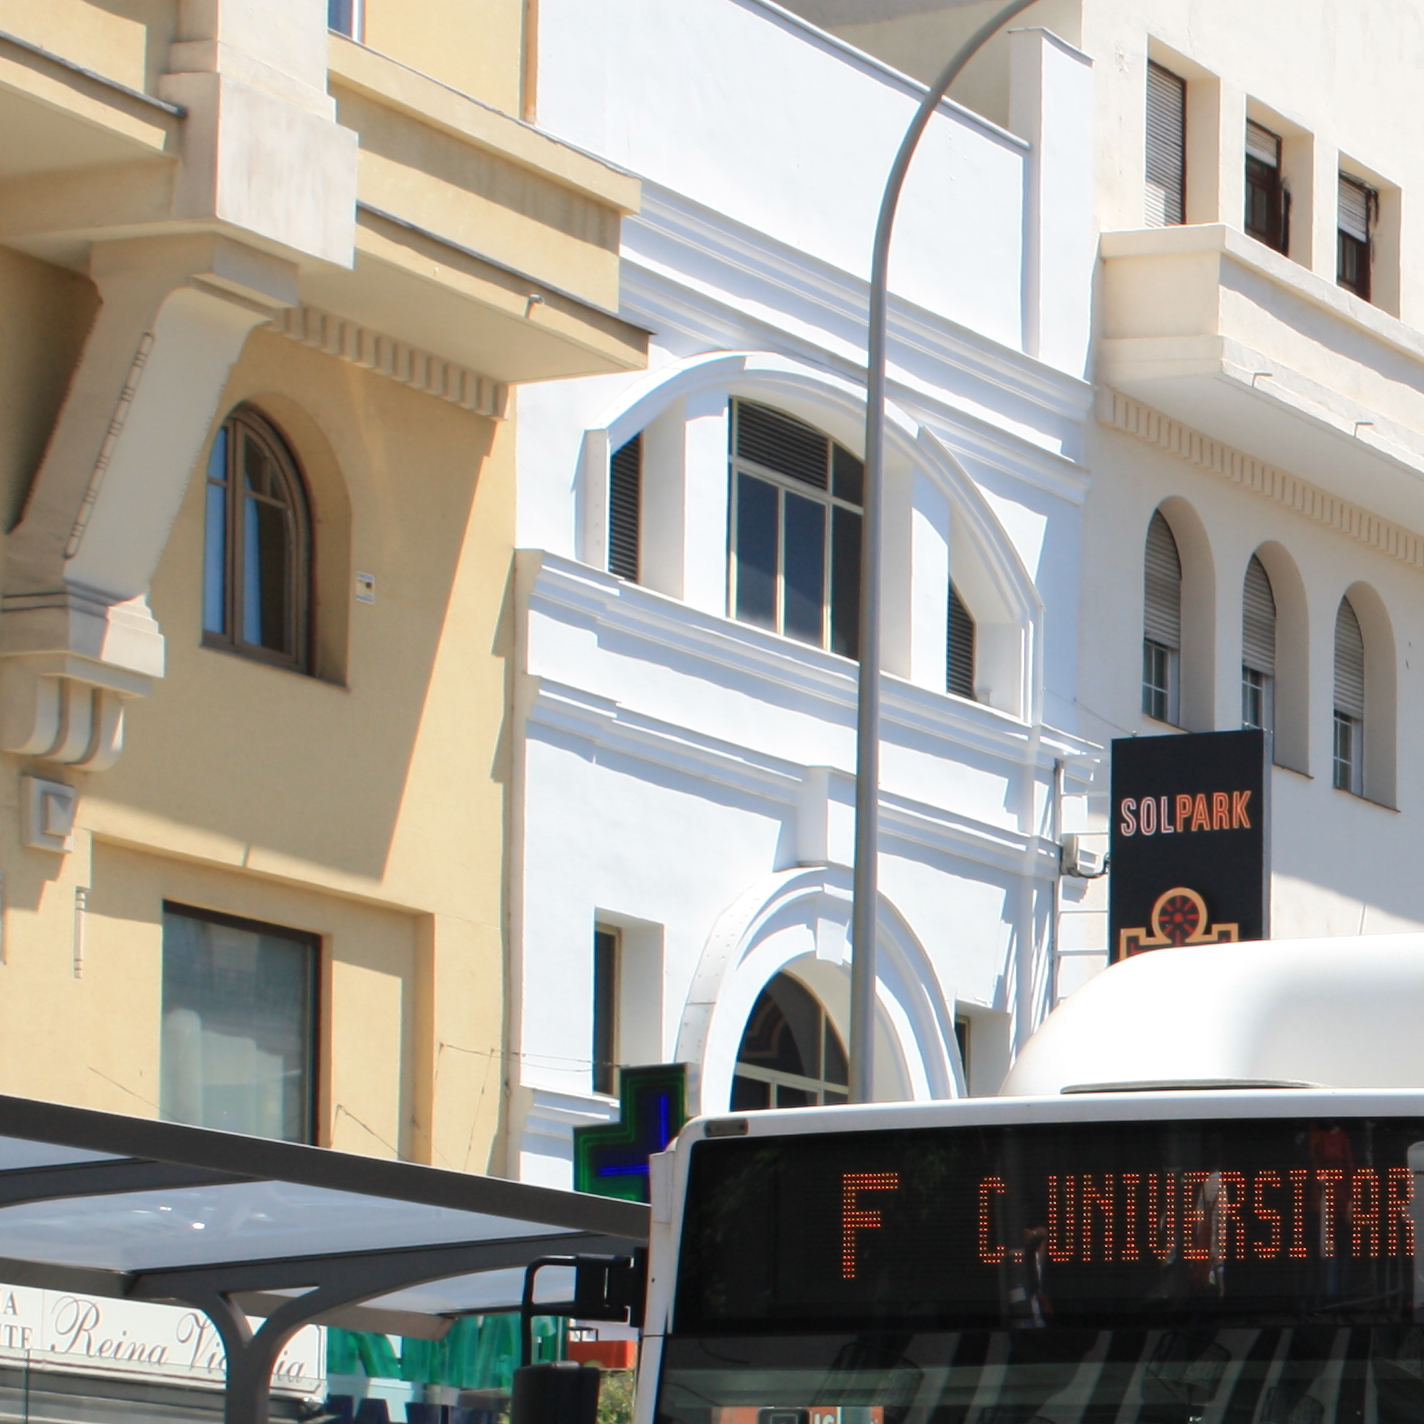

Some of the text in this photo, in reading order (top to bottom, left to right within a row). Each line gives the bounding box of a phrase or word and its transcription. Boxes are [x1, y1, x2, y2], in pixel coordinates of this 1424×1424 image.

[1121, 791, 1252, 836] SOLPARK
[843, 1172, 899, 1279] F
[979, 1176, 1024, 1264] C.
[50, 1295, 169, 1366] Reina
